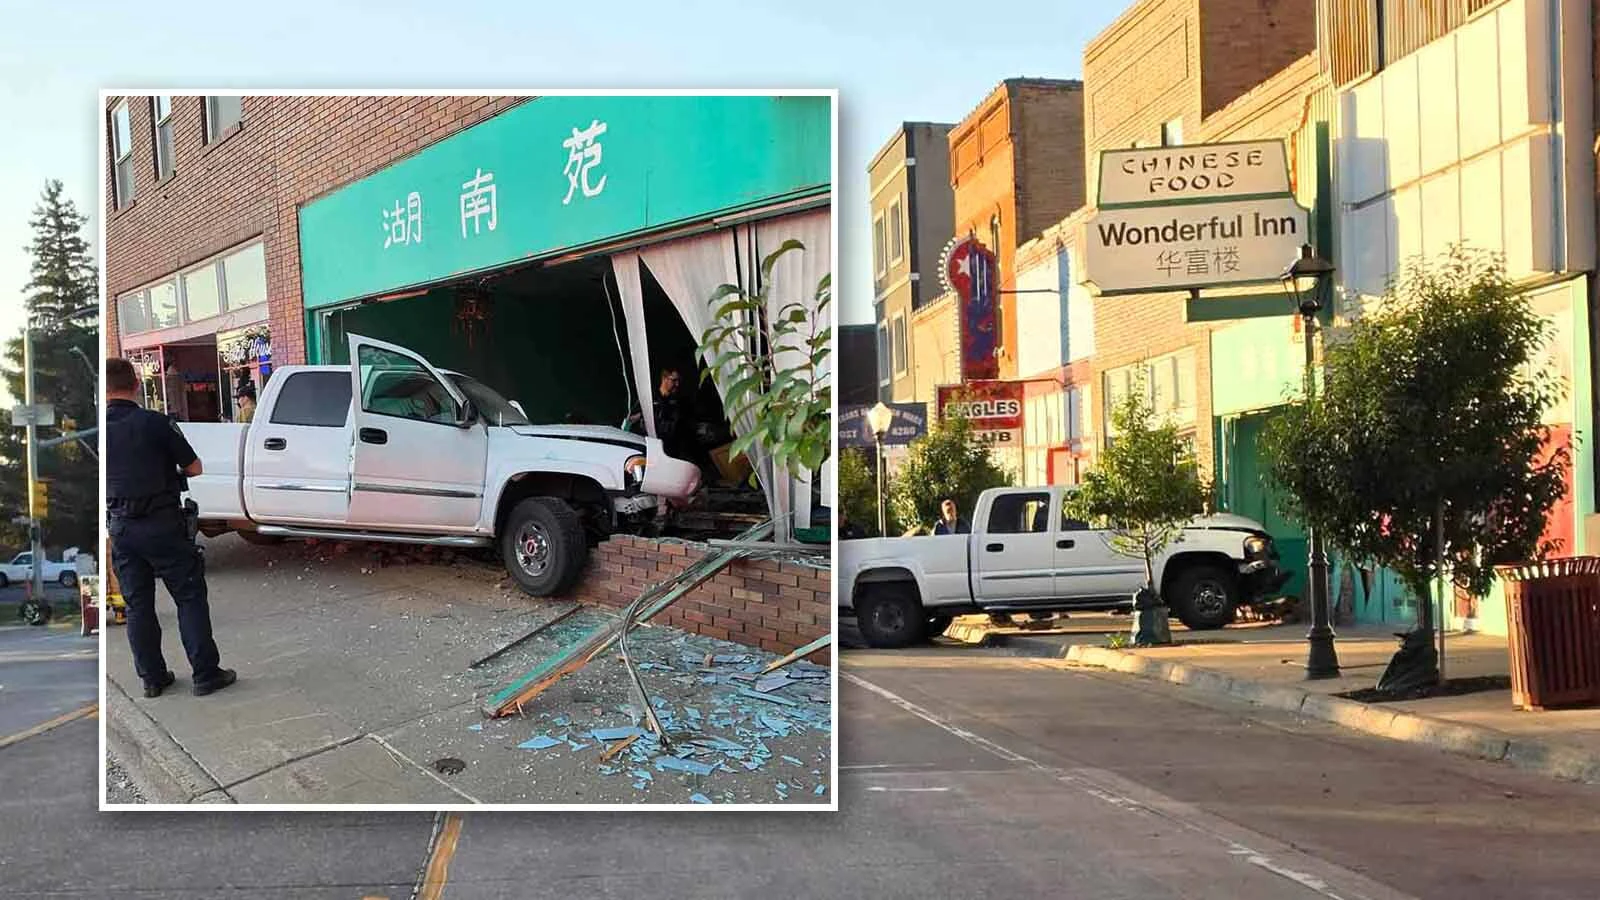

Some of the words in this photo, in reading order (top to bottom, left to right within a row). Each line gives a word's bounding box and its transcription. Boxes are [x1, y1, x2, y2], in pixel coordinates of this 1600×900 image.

[1121, 150, 1263, 174] CHINESE
[1149, 173, 1235, 193] FOOD
[1098, 214, 1242, 246] Wonderful
[1254, 212, 1296, 238] Inn
[1156, 247, 1241, 278] 华富楼
[969, 431, 1012, 444] LUB
